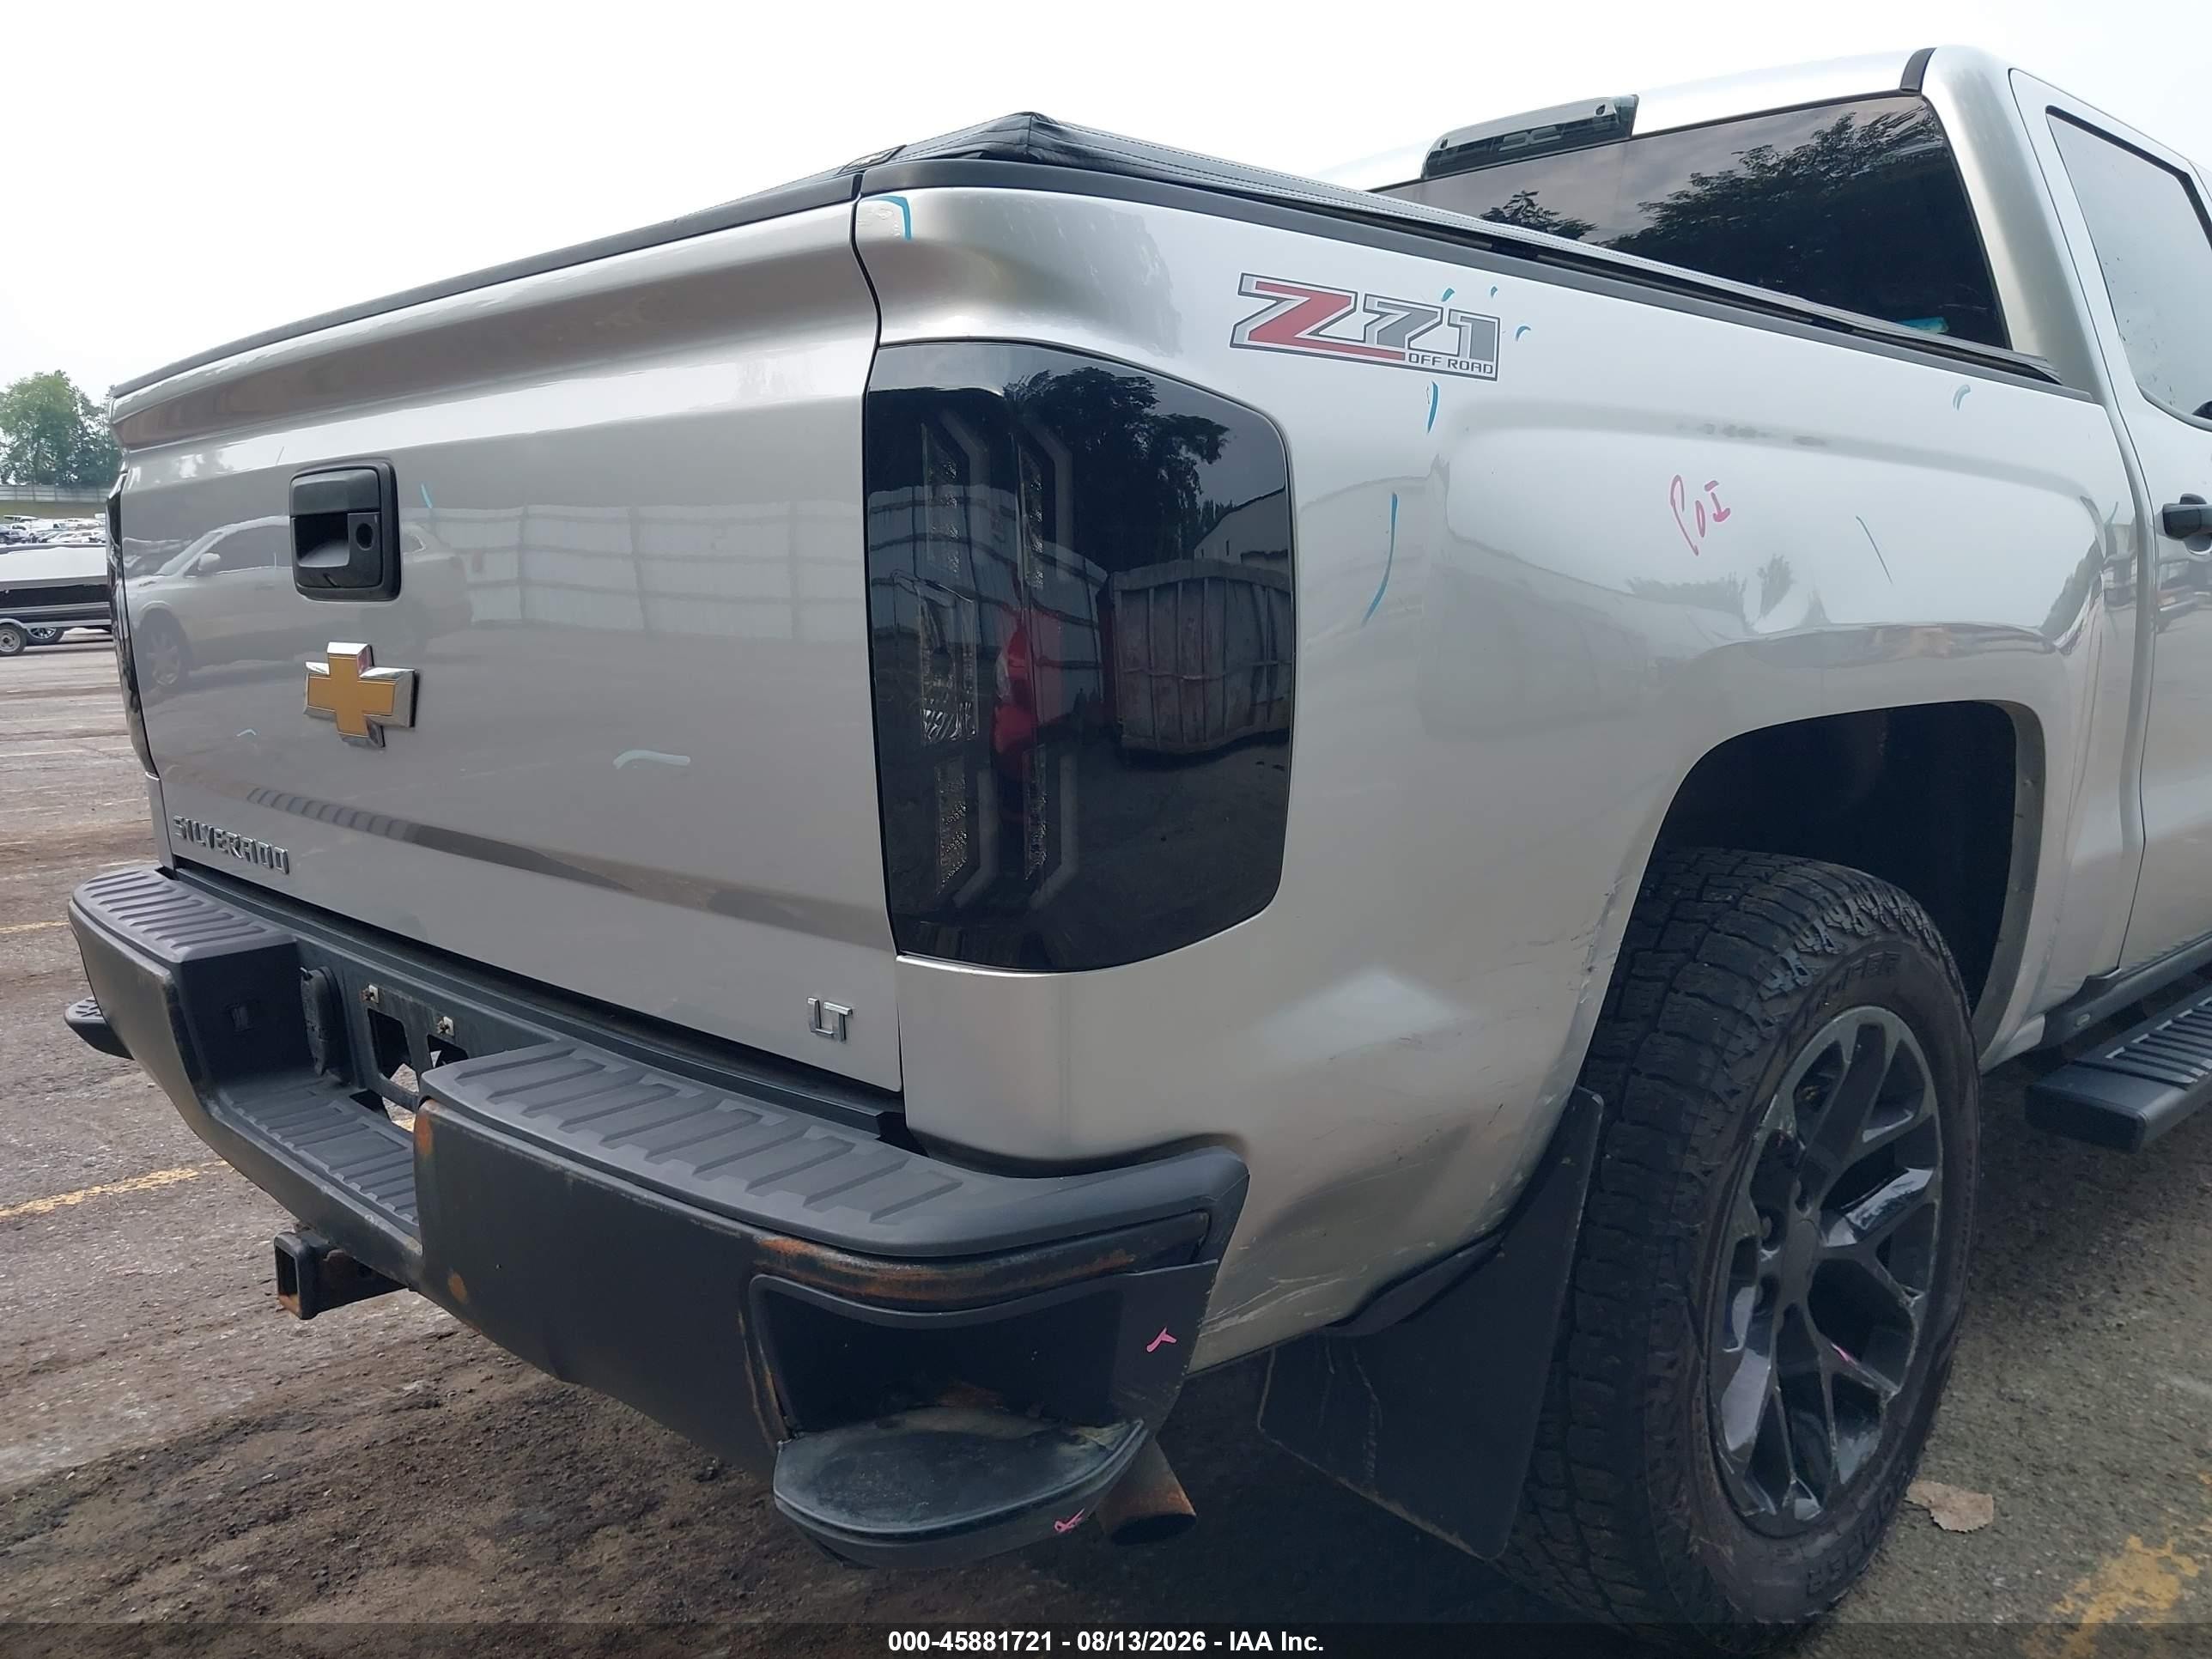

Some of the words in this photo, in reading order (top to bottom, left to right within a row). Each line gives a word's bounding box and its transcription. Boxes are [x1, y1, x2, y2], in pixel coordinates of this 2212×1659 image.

[1229, 272, 1501, 381] Z71
[1407, 352, 1443, 368] OFF
[1447, 358, 1494, 375] ROAD
[173, 814, 290, 875] SILVERADO
[806, 996, 854, 1042] LT
